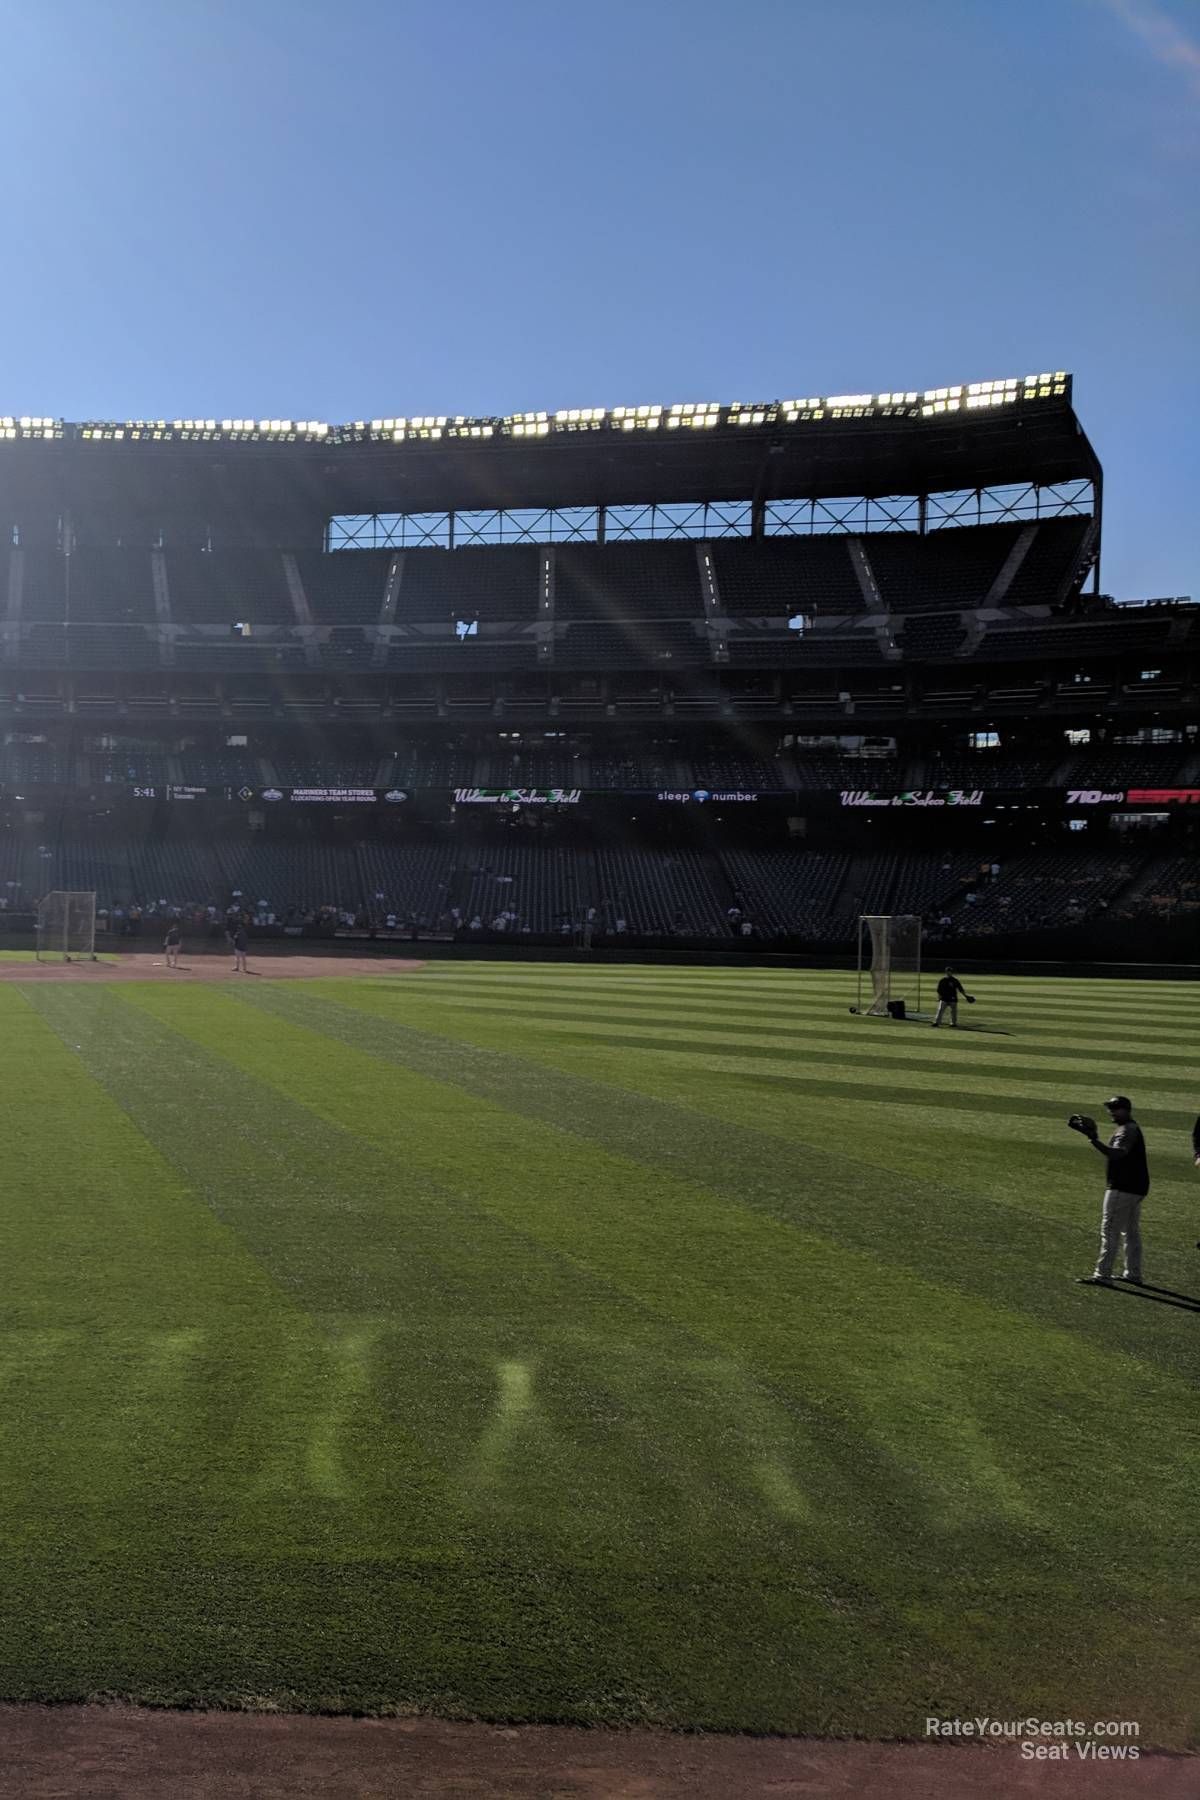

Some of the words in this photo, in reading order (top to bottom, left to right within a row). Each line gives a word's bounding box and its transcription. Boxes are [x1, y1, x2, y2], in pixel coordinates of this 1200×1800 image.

[134, 787, 155, 797] 5:41
[500, 793, 510, 803] to
[511, 789, 547, 803] Safeco
[549, 789, 581, 803] Field
[658, 791, 690, 803] sleep
[892, 795, 902, 806] to
[905, 790, 944, 806] Safeco
[947, 790, 984, 806] Field
[1126, 789, 1200, 804] ESPN
